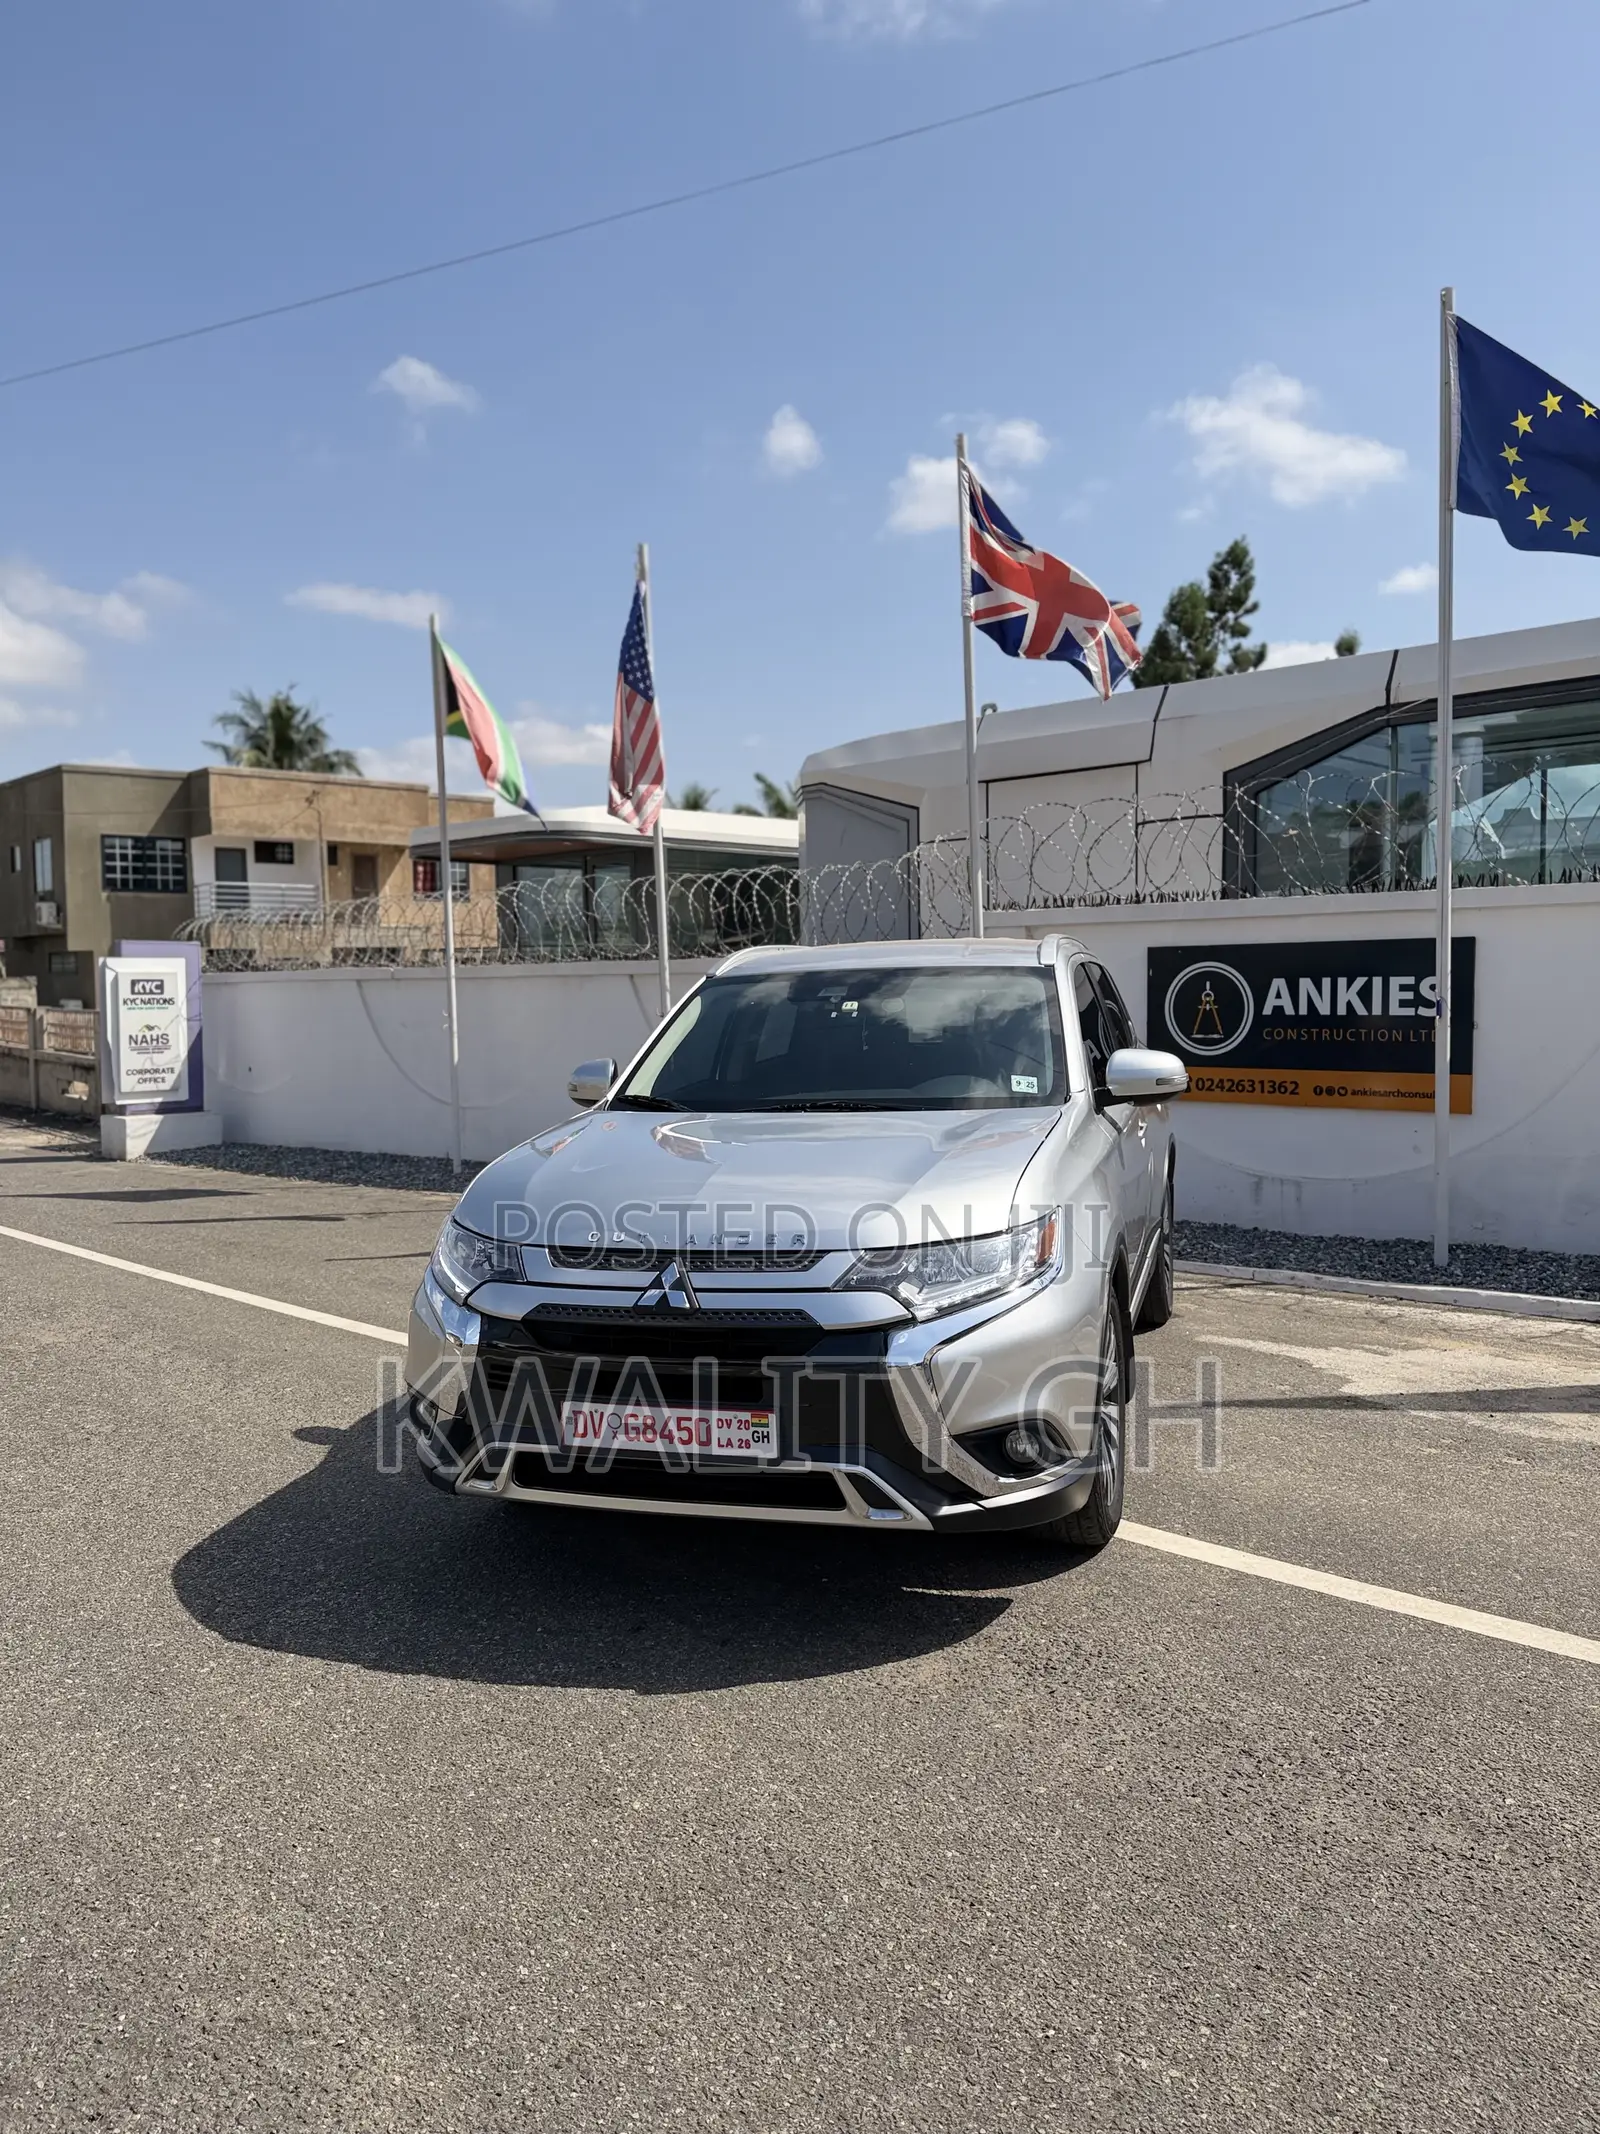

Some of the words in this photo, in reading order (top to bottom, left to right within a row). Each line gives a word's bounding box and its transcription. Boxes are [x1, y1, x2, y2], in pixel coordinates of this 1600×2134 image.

[134, 981, 161, 993] KYC
[122, 998, 139, 1006] KYC
[140, 997, 175, 1006] NATIONS
[1262, 975, 1438, 1017] ANKIES
[129, 1033, 170, 1046] NAHS
[1262, 1028, 1403, 1042] CONSTRUCTION
[126, 1067, 175, 1076] CORPORATE
[1026, 1081, 1035, 1089] 25
[1195, 1077, 1299, 1096] 0242631362
[588, 1231, 806, 1246] OUTLANDER
[572, 1410, 604, 1440] DV
[624, 1413, 712, 1447] G8450
[717, 1418, 732, 1430] DV
[737, 1419, 750, 1431] 20
[718, 1437, 733, 1449] LA
[738, 1438, 751, 1450] 26
[752, 1430, 770, 1444] GH
